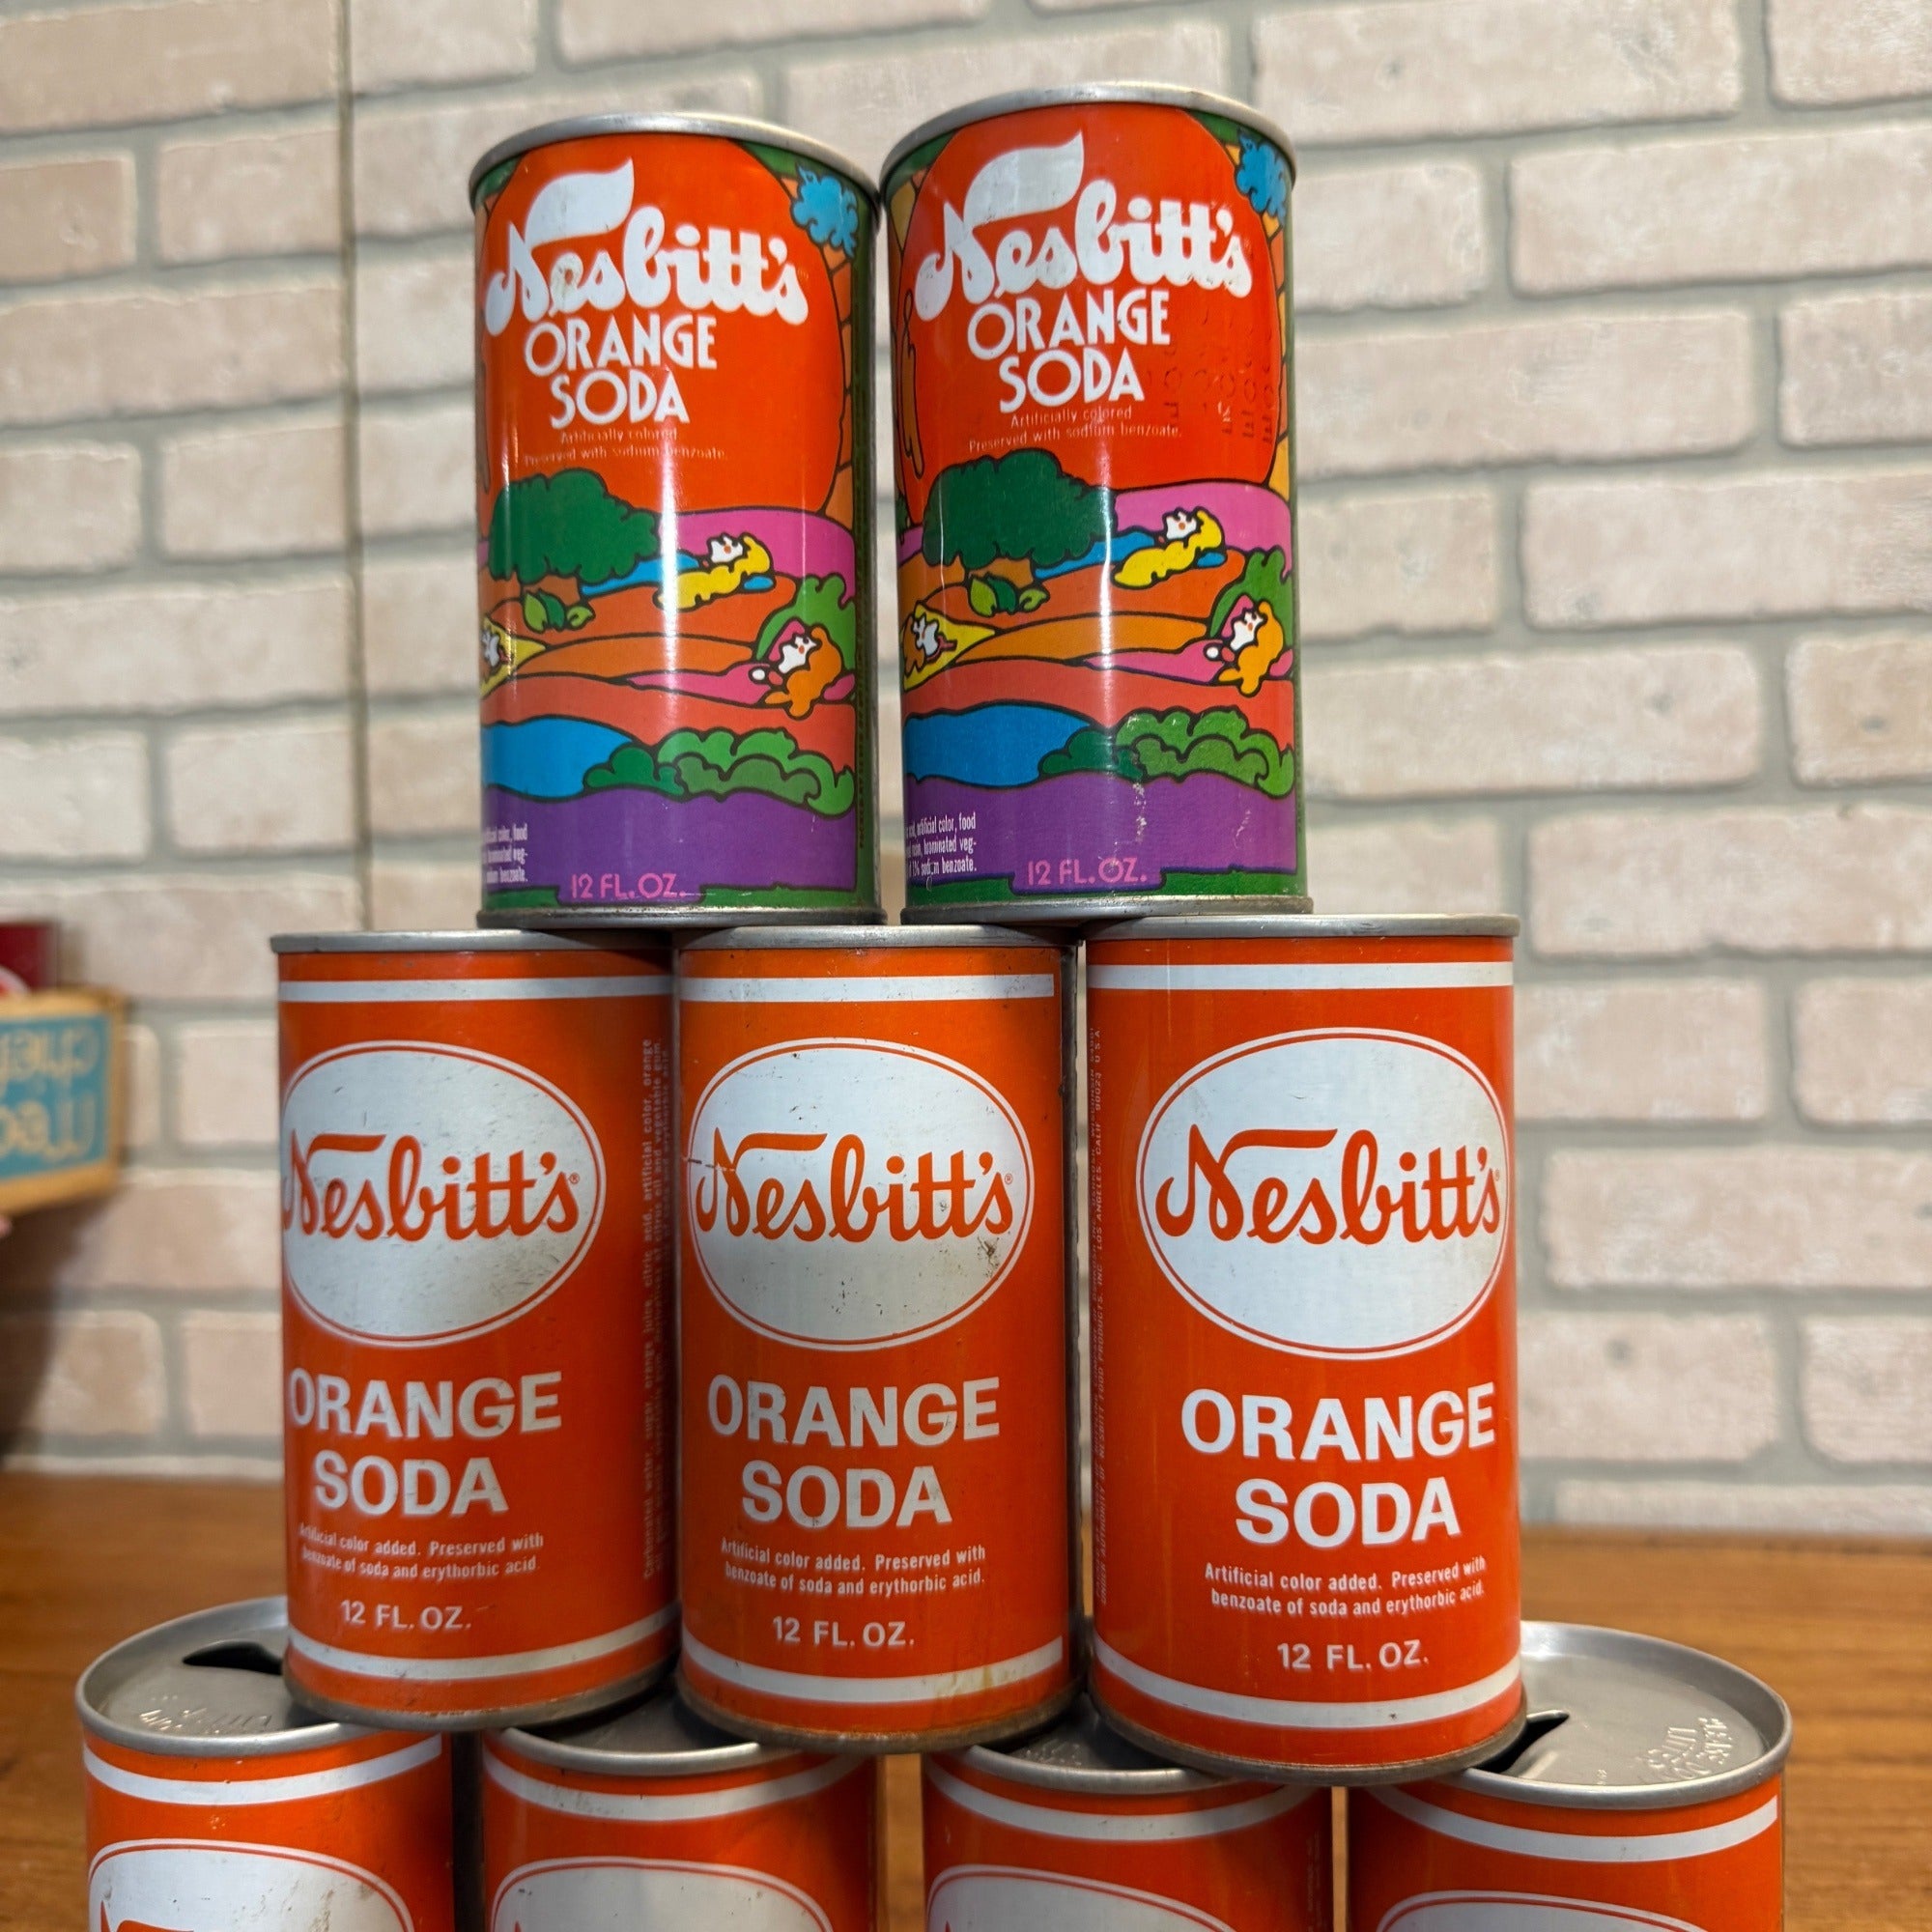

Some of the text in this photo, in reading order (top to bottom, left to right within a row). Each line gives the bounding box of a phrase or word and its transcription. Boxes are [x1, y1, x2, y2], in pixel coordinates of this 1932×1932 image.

[915, 130, 1252, 322] Nesbitt's
[486, 157, 809, 336] Nesbitt's
[967, 289, 1170, 361] ORANGE
[525, 314, 717, 377] ORANGE
[999, 347, 1145, 413] SODA
[550, 369, 690, 429] SODA
[1011, 406, 1132, 428] Artificially colored
[581, 445, 607, 459] with
[969, 433, 1027, 453] Preserved
[1034, 427, 1061, 443] with
[1066, 422, 1115, 438] sodium
[959, 811, 976, 830] food
[959, 838, 977, 854] veg-
[942, 856, 978, 874] benzoate.
[1028, 860, 1051, 886] 12
[571, 873, 593, 899] 12
[642, 1039, 653, 1087] orange
[641, 1140, 653, 1201] artificial
[696, 1126, 1013, 1242] Nesbitt's
[1154, 1123, 1500, 1245] Nesbitt's
[291, 1367, 561, 1439] ORANGE
[708, 1374, 999, 1448] ORANGE
[1181, 1381, 1494, 1461] ORANGE
[313, 1449, 509, 1518] SODA
[742, 1460, 952, 1528] SODA
[1236, 1476, 1461, 1548] SODA
[339, 1530, 369, 1552] color
[375, 1538, 420, 1556] added.
[429, 1536, 504, 1556] Preserved
[511, 1532, 543, 1550] with
[721, 1537, 986, 1572] Artificial color added. Preserved with
[345, 1556, 356, 1573] of
[360, 1560, 389, 1577] soda
[393, 1561, 417, 1579] and
[422, 1561, 499, 1582] erythorbic
[725, 1561, 985, 1598] benzoate of soda and erythorbic acid.
[1205, 1555, 1486, 1592] Artificial color added. Preserved with
[341, 1600, 365, 1625] 12
[1210, 1580, 1484, 1617] benzoate of soda and erythorbic acid.
[773, 1616, 801, 1642] 12
[1277, 1643, 1311, 1670] 12
